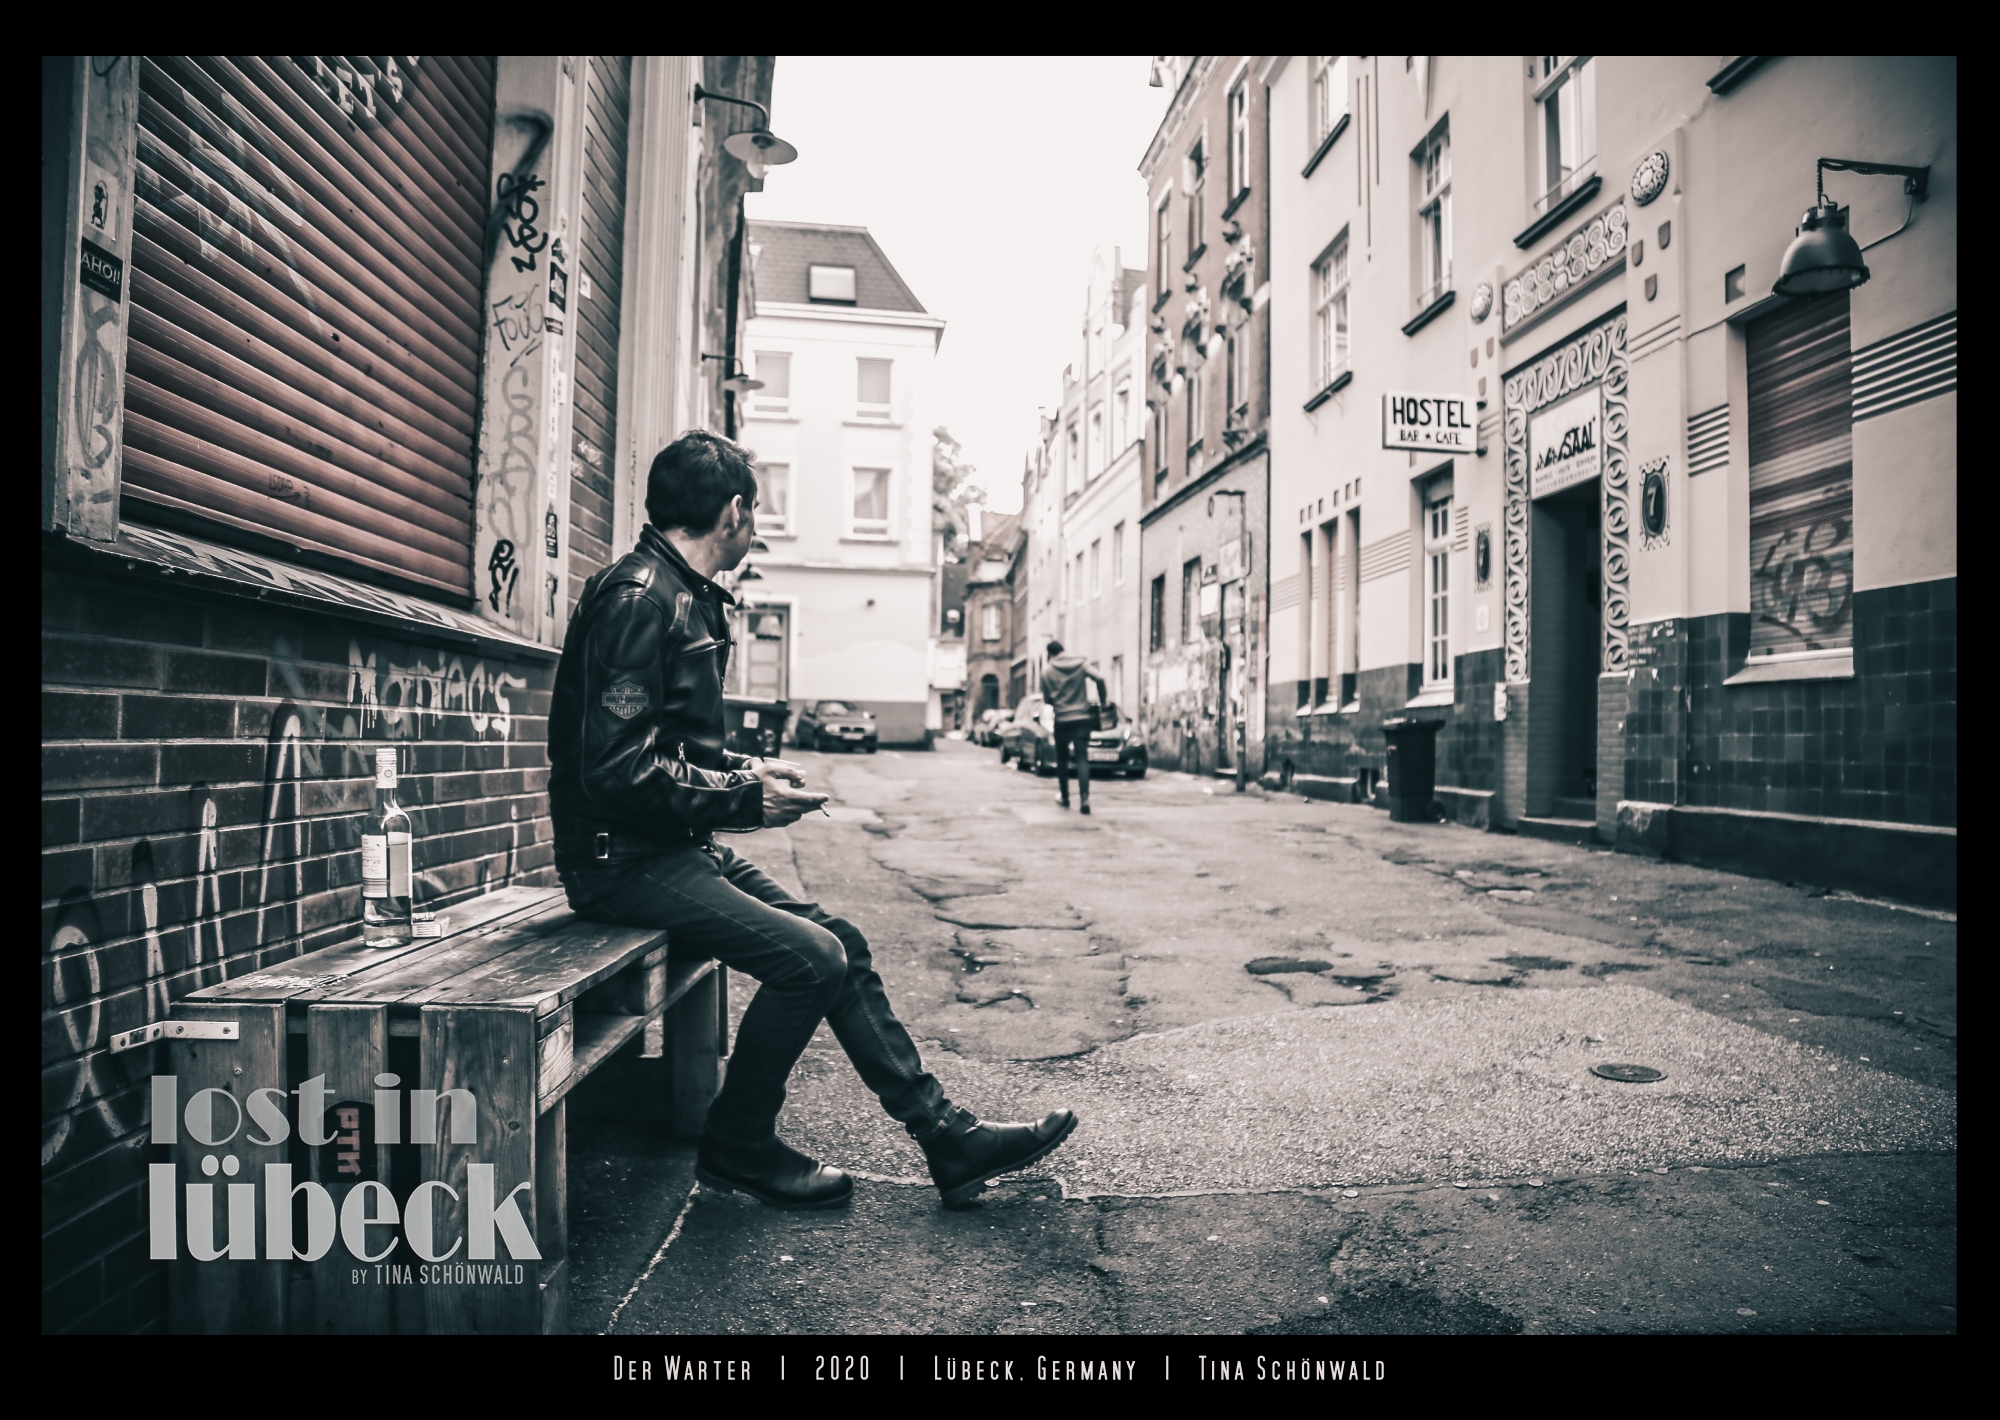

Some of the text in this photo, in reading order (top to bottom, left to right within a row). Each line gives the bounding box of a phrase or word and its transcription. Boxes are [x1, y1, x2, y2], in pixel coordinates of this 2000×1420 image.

[81, 252, 121, 285] AHOI!
[1392, 396, 1471, 429] HOSTEL
[1400, 429, 1420, 442] BAR
[1647, 486, 1658, 517] 7
